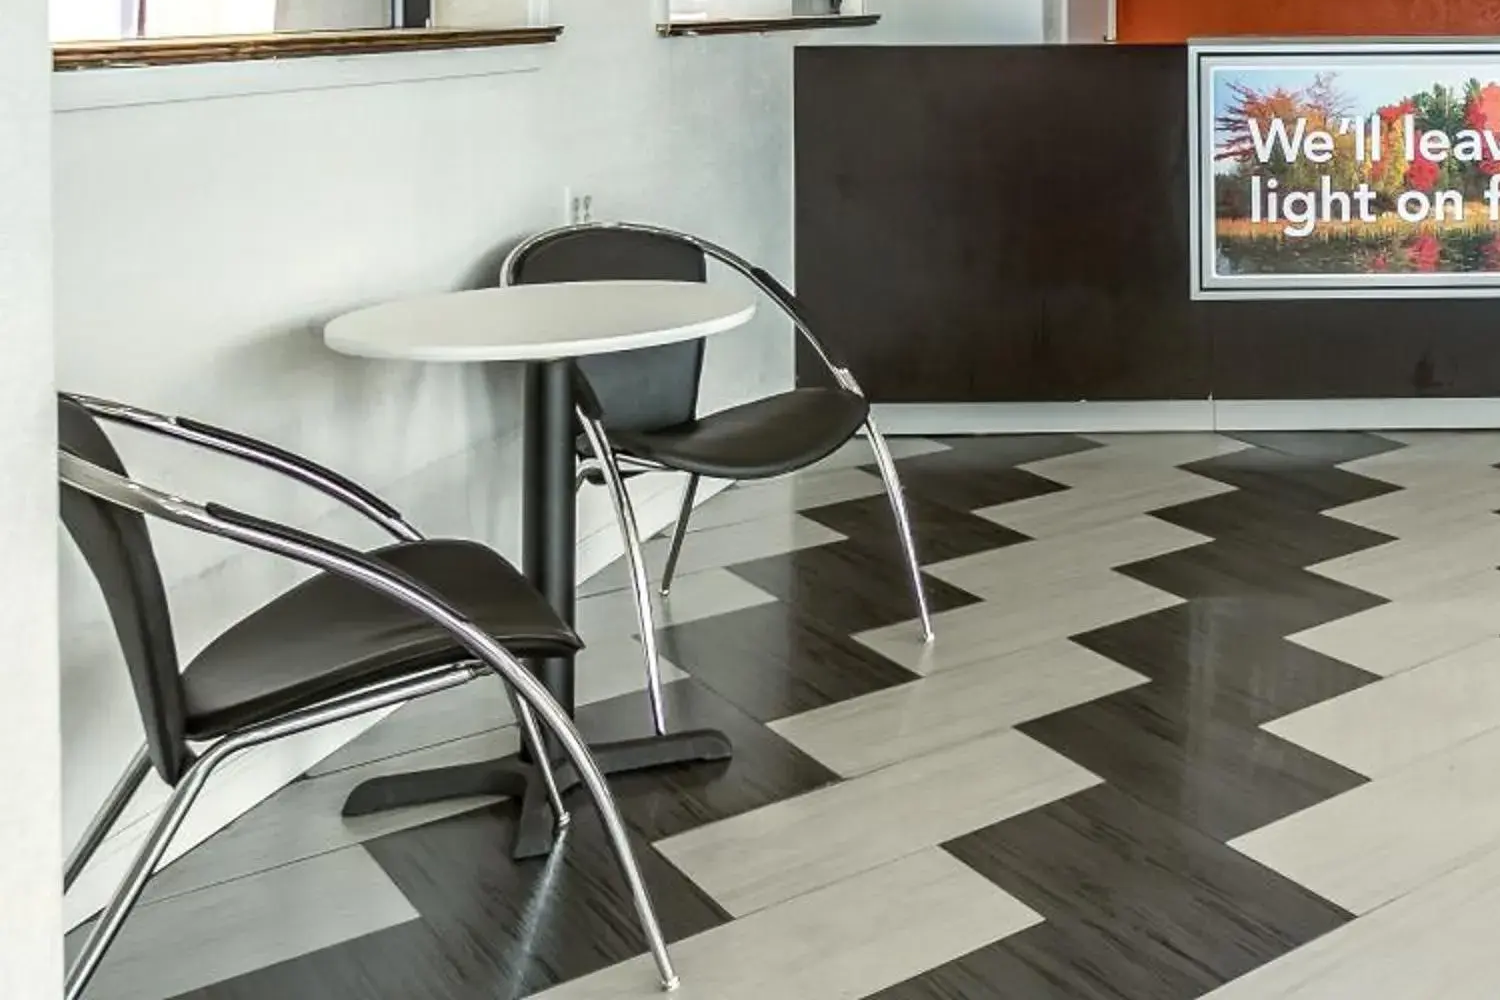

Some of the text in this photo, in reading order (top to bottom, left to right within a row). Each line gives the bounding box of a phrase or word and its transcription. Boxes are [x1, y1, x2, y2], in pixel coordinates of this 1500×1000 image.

[1248, 114, 1381, 163] We'll
[1251, 175, 1377, 237] light
[1397, 190, 1464, 222] on
